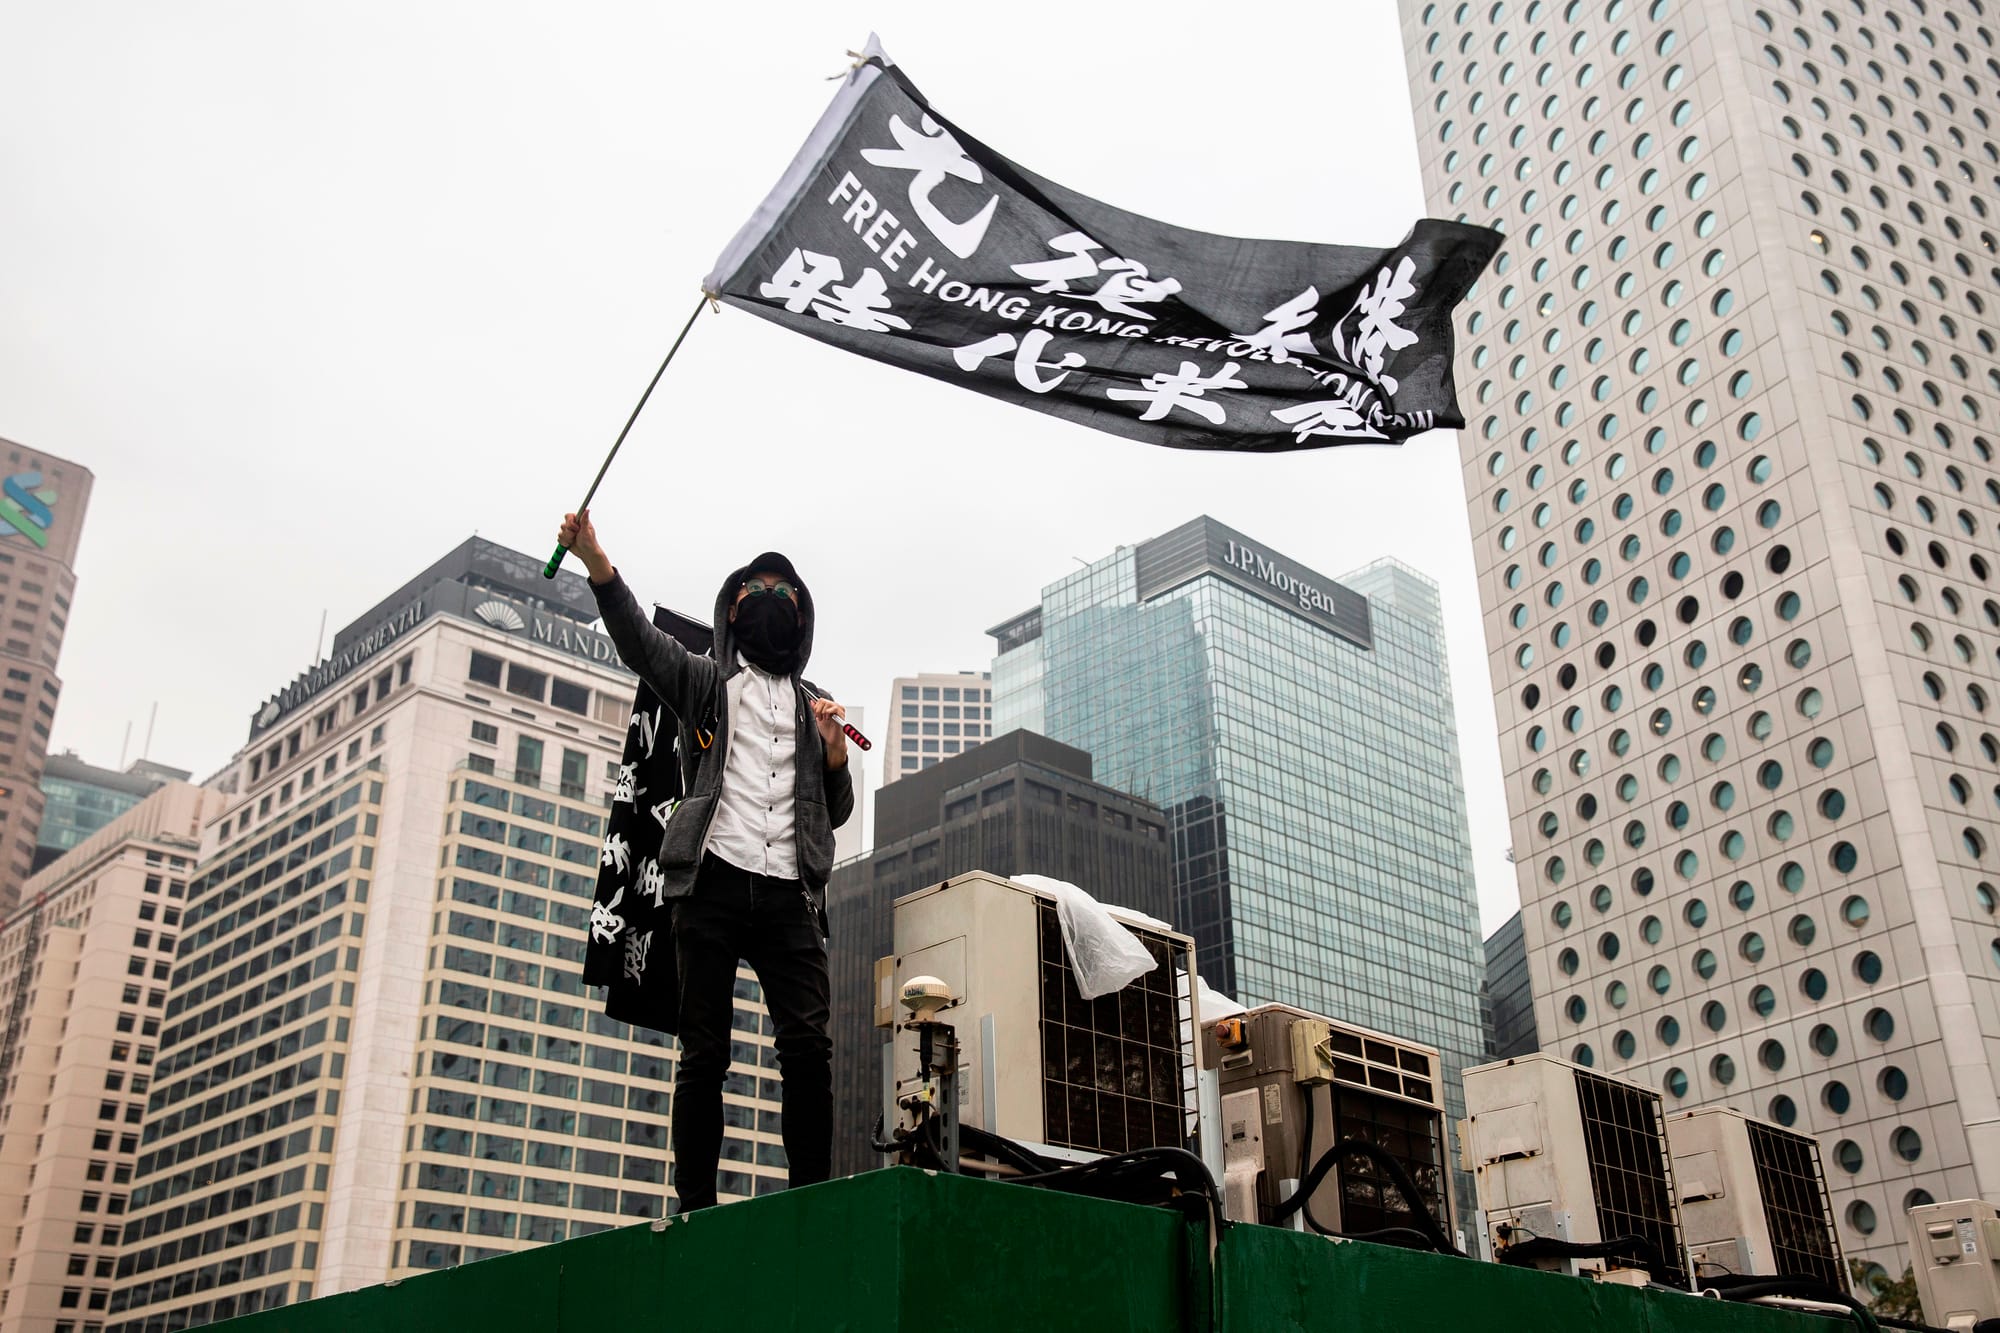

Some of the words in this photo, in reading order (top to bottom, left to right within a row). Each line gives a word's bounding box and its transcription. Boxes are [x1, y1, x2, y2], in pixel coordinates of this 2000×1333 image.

[828, 170, 918, 272] FREE
[909, 257, 1030, 321] HONG
[1032, 304, 1150, 338] KONG
[1154, 335, 1374, 413] REVOLION
[1223, 539, 1337, 612] J.P.Morgan
[352, 600, 424, 665] ORIENTAL
[532, 617, 630, 670] MANDA
